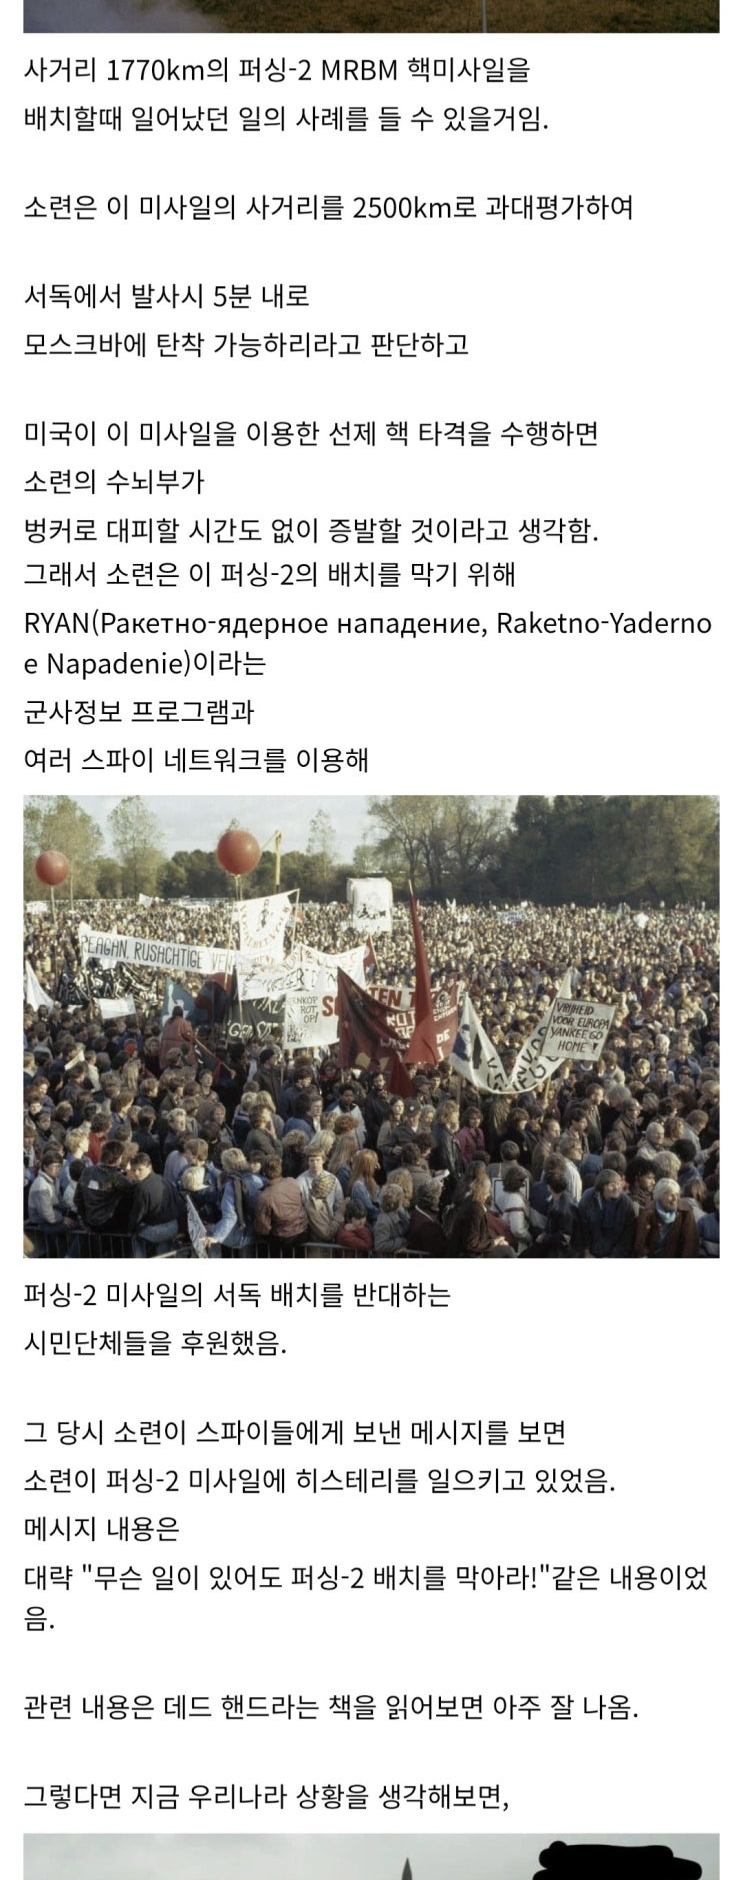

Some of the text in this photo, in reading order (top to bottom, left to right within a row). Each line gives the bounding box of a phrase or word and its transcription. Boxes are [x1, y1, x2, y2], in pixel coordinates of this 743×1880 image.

[557, 1002, 595, 1016] VRIJHEID
[552, 1015, 610, 1030] VOOR EUROPA
[550, 1026, 604, 1040] YANKEE GO
[557, 1040, 588, 1053] HOME
